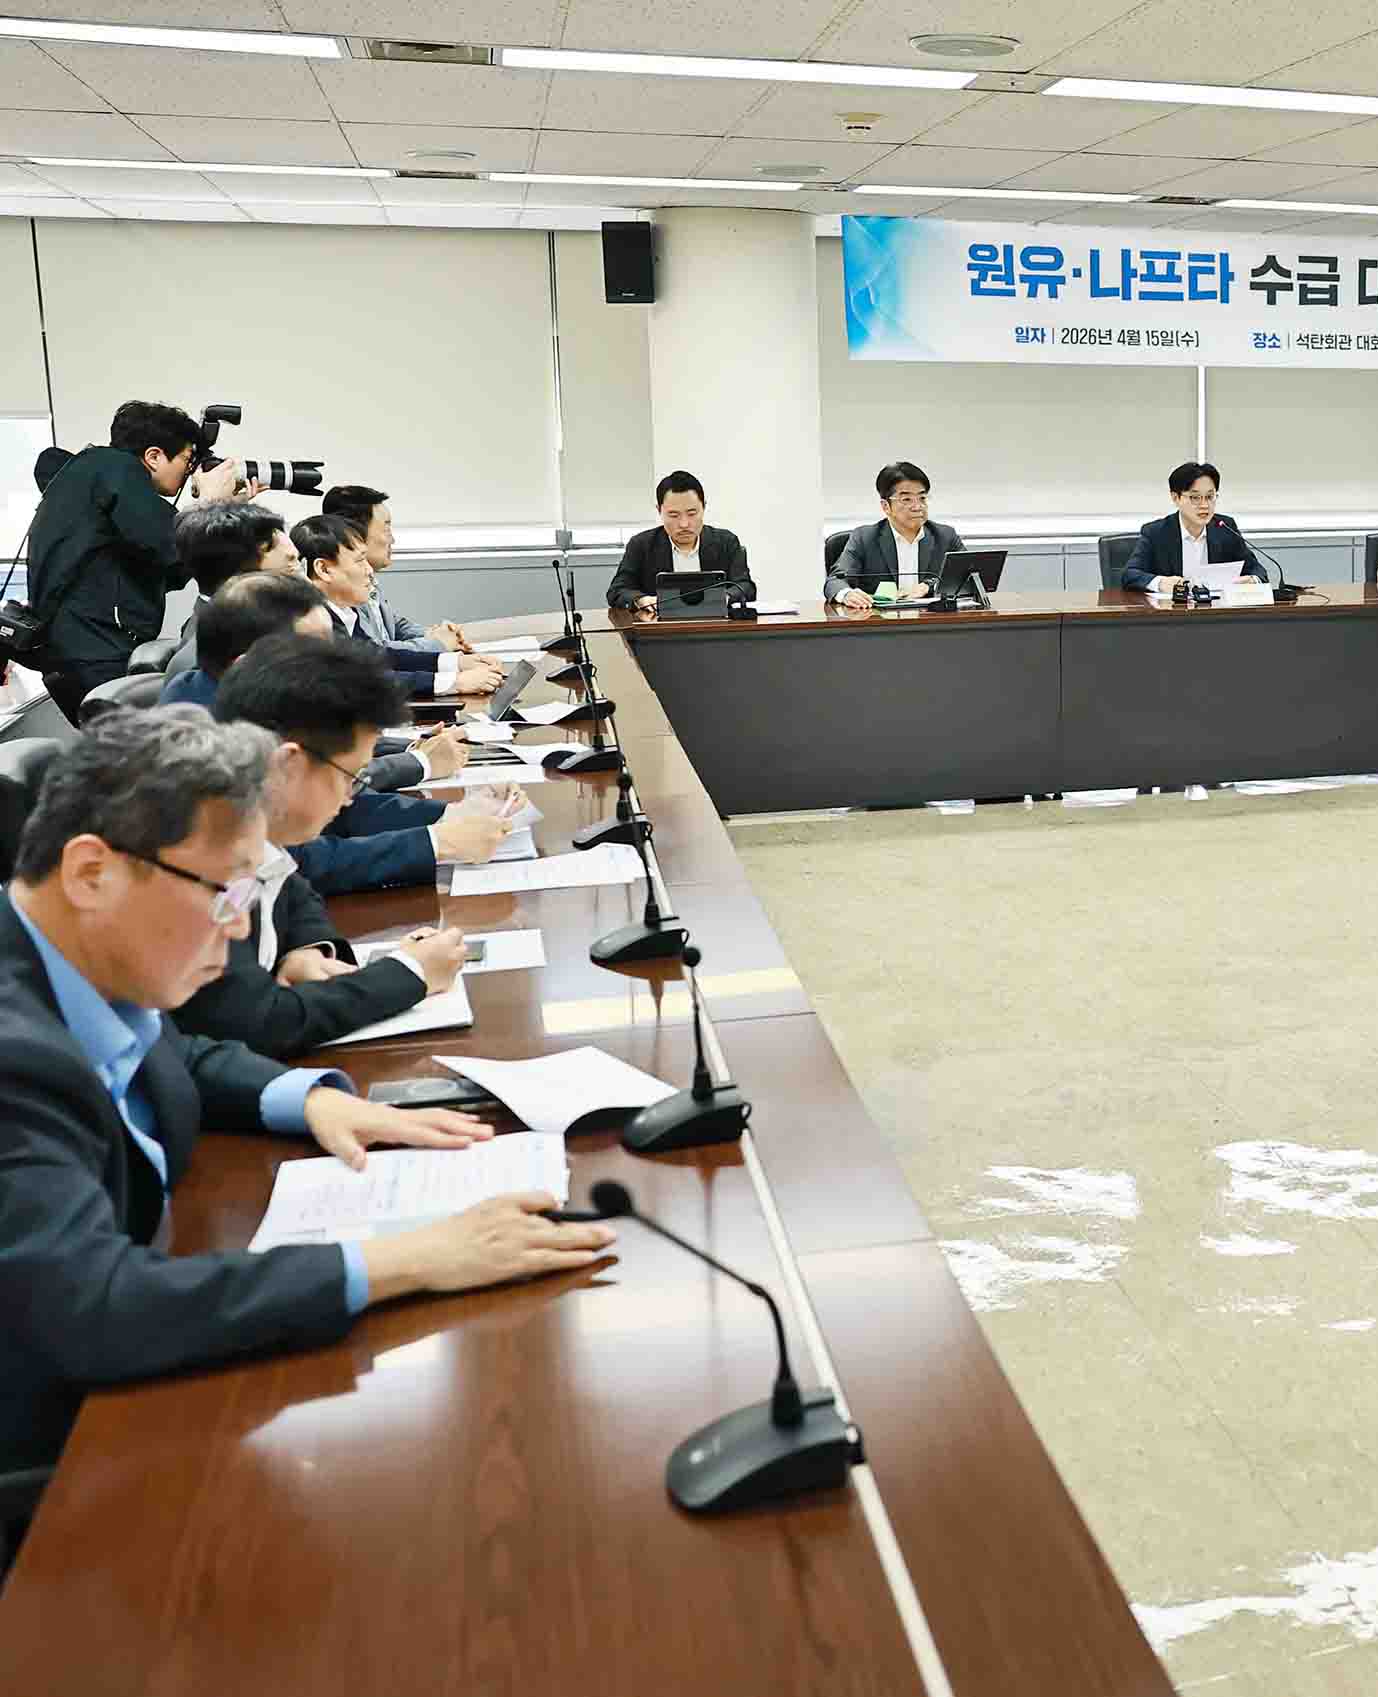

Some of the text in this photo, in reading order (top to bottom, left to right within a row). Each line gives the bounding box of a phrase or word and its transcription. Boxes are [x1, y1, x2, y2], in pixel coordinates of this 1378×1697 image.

[967, 243, 1235, 304] 원유·나프타
[1249, 254, 1341, 306] 수급
[1014, 326, 1046, 344] 일자
[1060, 327, 1113, 346] 2026년
[1117, 329, 1142, 347] 4월
[1252, 331, 1281, 349] 장소
[1296, 333, 1352, 351] 석탄회관
